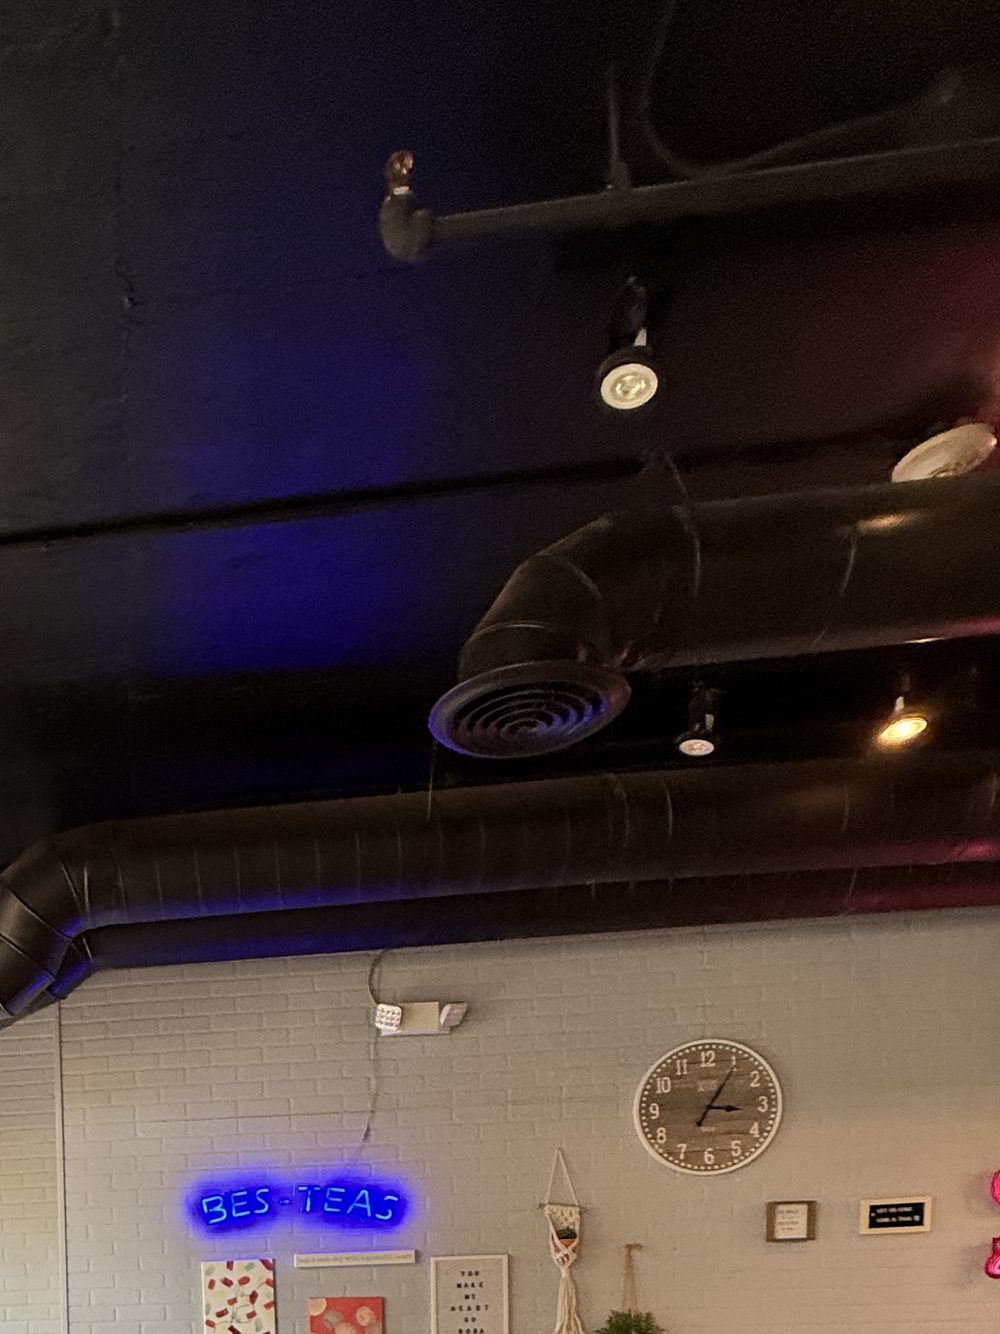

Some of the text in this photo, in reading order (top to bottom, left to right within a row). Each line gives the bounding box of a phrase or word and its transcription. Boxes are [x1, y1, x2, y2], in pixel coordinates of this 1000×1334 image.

[675, 1059, 689, 1075] 11
[699, 1050, 716, 1068] 12
[655, 1077, 671, 1094] 10
[750, 1071, 761, 1087] 2
[649, 1103, 660, 1120] 9
[758, 1096, 768, 1112] 3
[656, 1127, 667, 1144] 8
[749, 1121, 760, 1138] 4
[676, 1143, 687, 1160] 7
[703, 1148, 715, 1165] 6
[730, 1140, 742, 1157] 5
